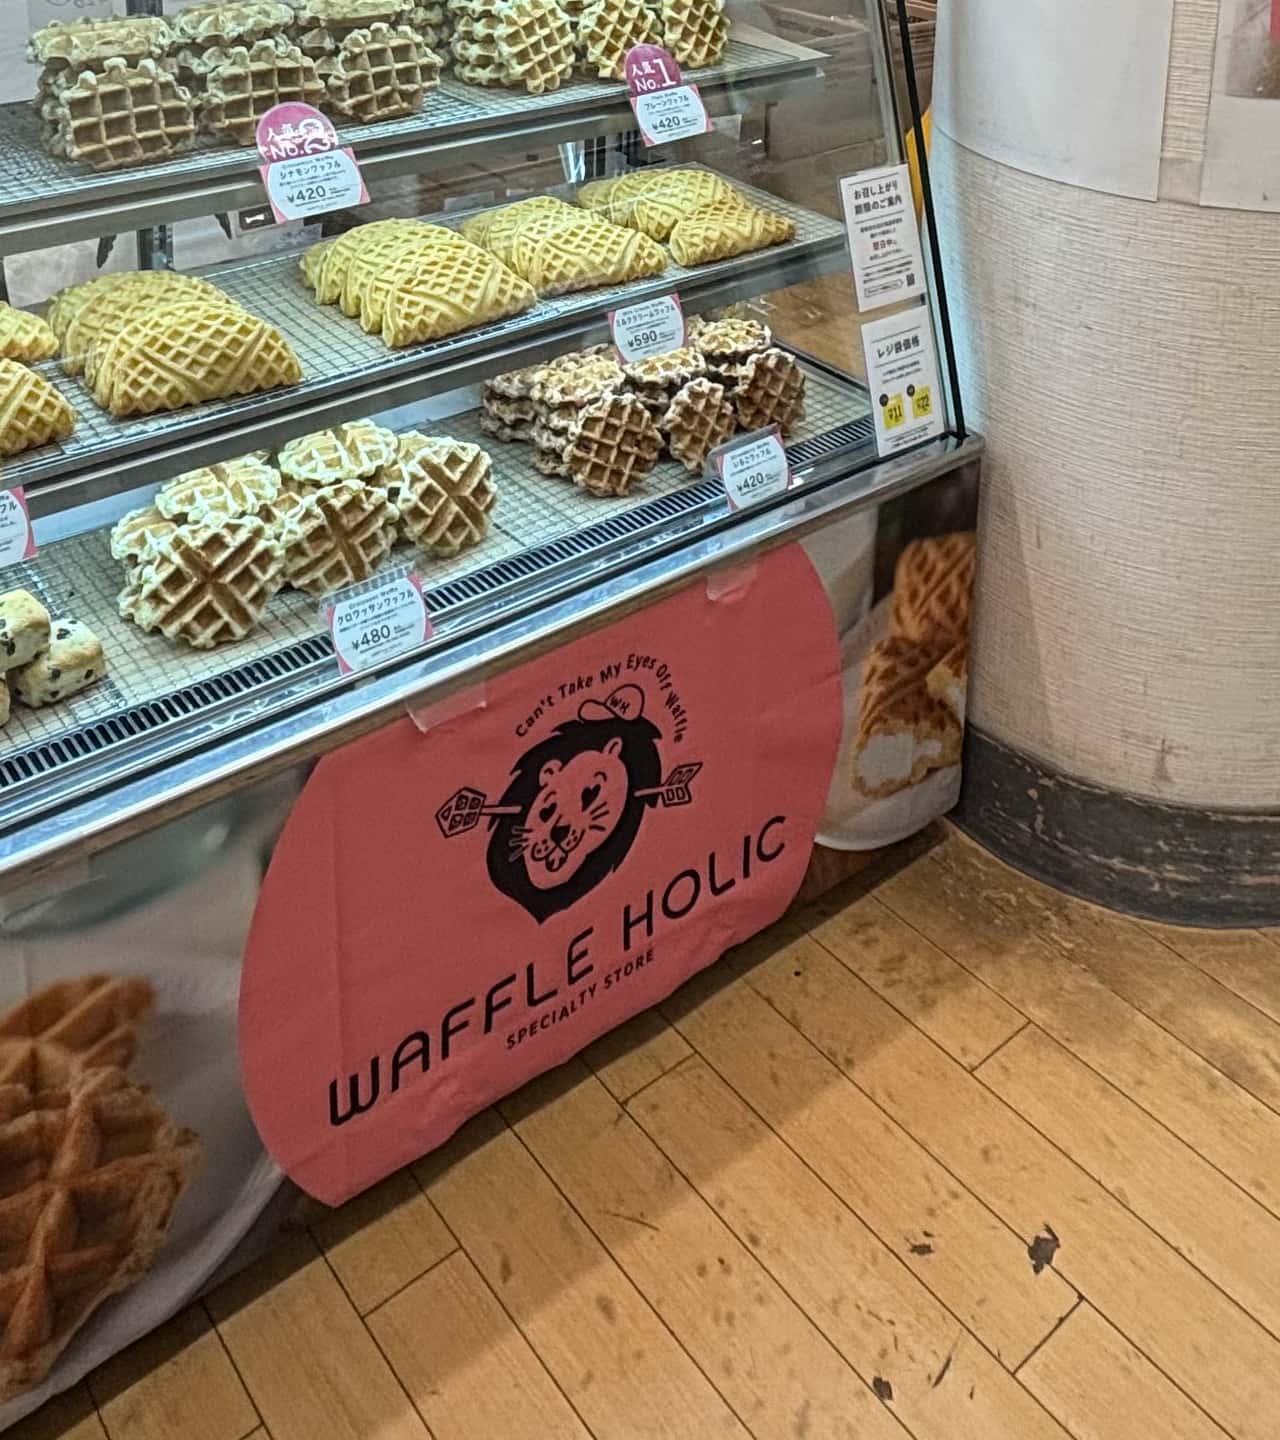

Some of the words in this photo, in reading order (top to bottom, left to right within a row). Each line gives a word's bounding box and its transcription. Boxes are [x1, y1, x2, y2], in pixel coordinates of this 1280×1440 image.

[651, 117, 680, 131] ¥420
[280, 161, 341, 179] シナモンワッフル
[287, 185, 326, 203] ¥420
[736, 472, 764, 491] ¥420
[337, 590, 413, 626] クロワッサンワッフル
[351, 625, 390, 650] ¥480
[515, 695, 554, 737] Can't
[558, 676, 593, 699] Take
[600, 662, 621, 684] My
[626, 654, 656, 672] Eyes
[656, 664, 672, 691] Off
[665, 691, 688, 743] Waffle
[329, 927, 594, 1126] WAFFLE
[623, 815, 787, 951] HOLIC
[506, 987, 598, 1050] SPECIALTY
[605, 948, 655, 990] STORE
